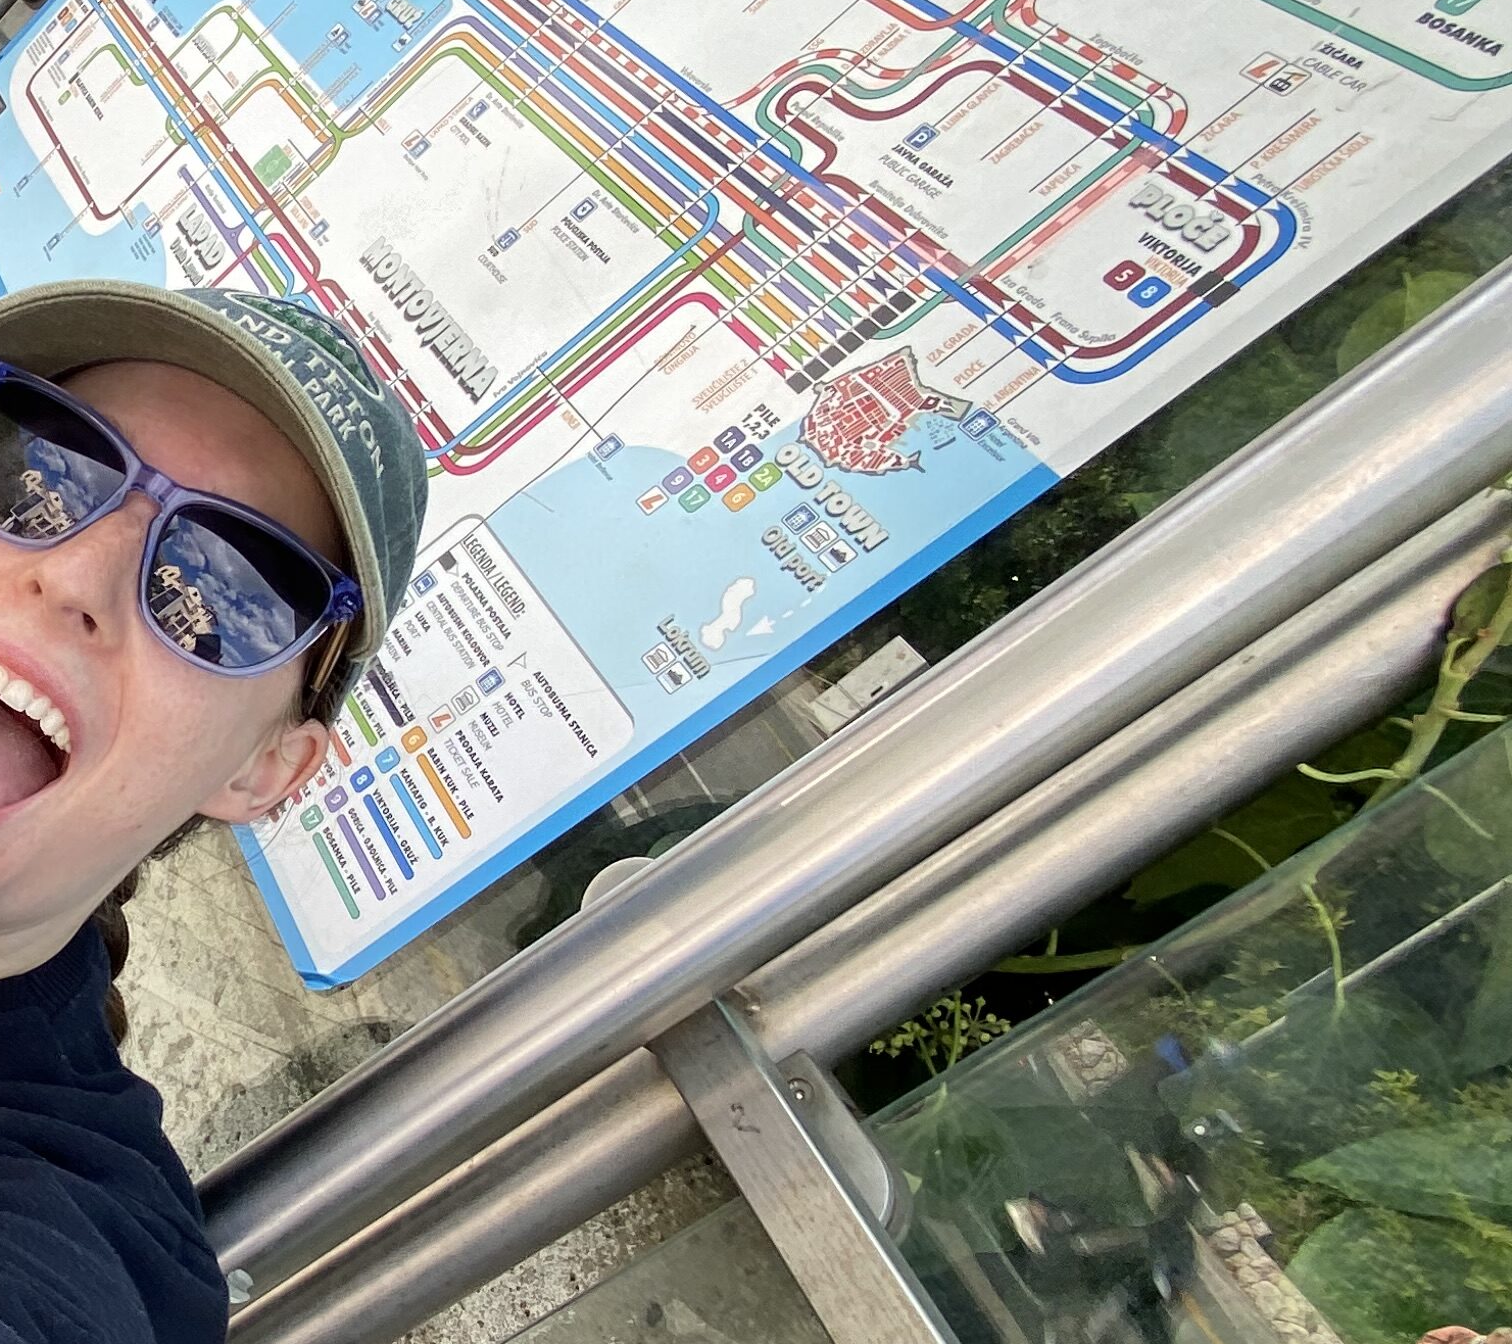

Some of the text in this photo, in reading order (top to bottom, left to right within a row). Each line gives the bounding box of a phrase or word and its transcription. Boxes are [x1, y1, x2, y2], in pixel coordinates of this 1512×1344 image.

[1088, 33, 1143, 67] Zagrebačka
[1413, 9, 1507, 59] BOSANKA
[1299, 54, 1368, 94] CABLE CAR
[878, 153, 942, 201] PUBLIC GARAGE
[891, 142, 955, 188] JAVNA GARAŽA
[1037, 163, 1082, 198] KAPELICA
[1250, 172, 1278, 195] Petra
[175, 204, 228, 272] LAPAD
[1125, 182, 1231, 254] PLOČE
[549, 224, 589, 263] POLICE STATION
[585, 239, 612, 265] POSTAJA
[1136, 231, 1203, 278] VIKTORIJA
[1000, 273, 1048, 312] Iza Grada
[1115, 266, 1159, 302] 5 8
[358, 235, 502, 402] MONTOVJERNA
[926, 324, 978, 363] IZA GRADA
[301, 377, 357, 442] PARK
[982, 366, 1041, 410] H. ARGENTINA
[308, 347, 390, 480] TETON
[740, 412, 771, 442] 1,2,3
[752, 402, 781, 428] PILE
[1006, 416, 1028, 435] Grand
[696, 452, 745, 503] 3 4 6
[720, 431, 775, 487] 1A 1B 2A
[667, 470, 707, 512] 9 17
[774, 443, 890, 554] OLD TOWN
[460, 534, 496, 576] LEGENDA
[491, 577, 527, 619] LEGEND:
[760, 525, 825, 594] Old port
[402, 619, 420, 639] PORT
[413, 611, 432, 632] LUKA
[424, 600, 475, 669] CENTRAL BUS STATION
[449, 581, 503, 652] DEPARTURE BUS STOP
[484, 606, 513, 639] POSTAJA
[656, 614, 714, 680] Lokrum
[491, 701, 514, 728] HOTEL
[503, 692, 525, 720] HOTEL
[520, 679, 553, 719] BUS STOP
[532, 670, 598, 758] AUTOBUSNA STANICA
[340, 730, 355, 748] PILE
[372, 722, 386, 738] PILE
[467, 720, 492, 751] MUSEUM
[478, 712, 500, 737] MUZEJ
[408, 734, 475, 820] 6 BABIN KUK PILE
[442, 738, 479, 789] TICKET SALE
[453, 730, 505, 803] PRODAJA KARATA
[355, 774, 420, 865] 8 VIKTORIJA GRUŽ
[381, 754, 449, 847] 7 KANTAFIG B. KUK
[303, 810, 319, 826] 17
[321, 826, 349, 868] BOSANKA
[345, 874, 361, 894] PILE
[329, 793, 341, 805] 9
[383, 878, 399, 895] PILE
